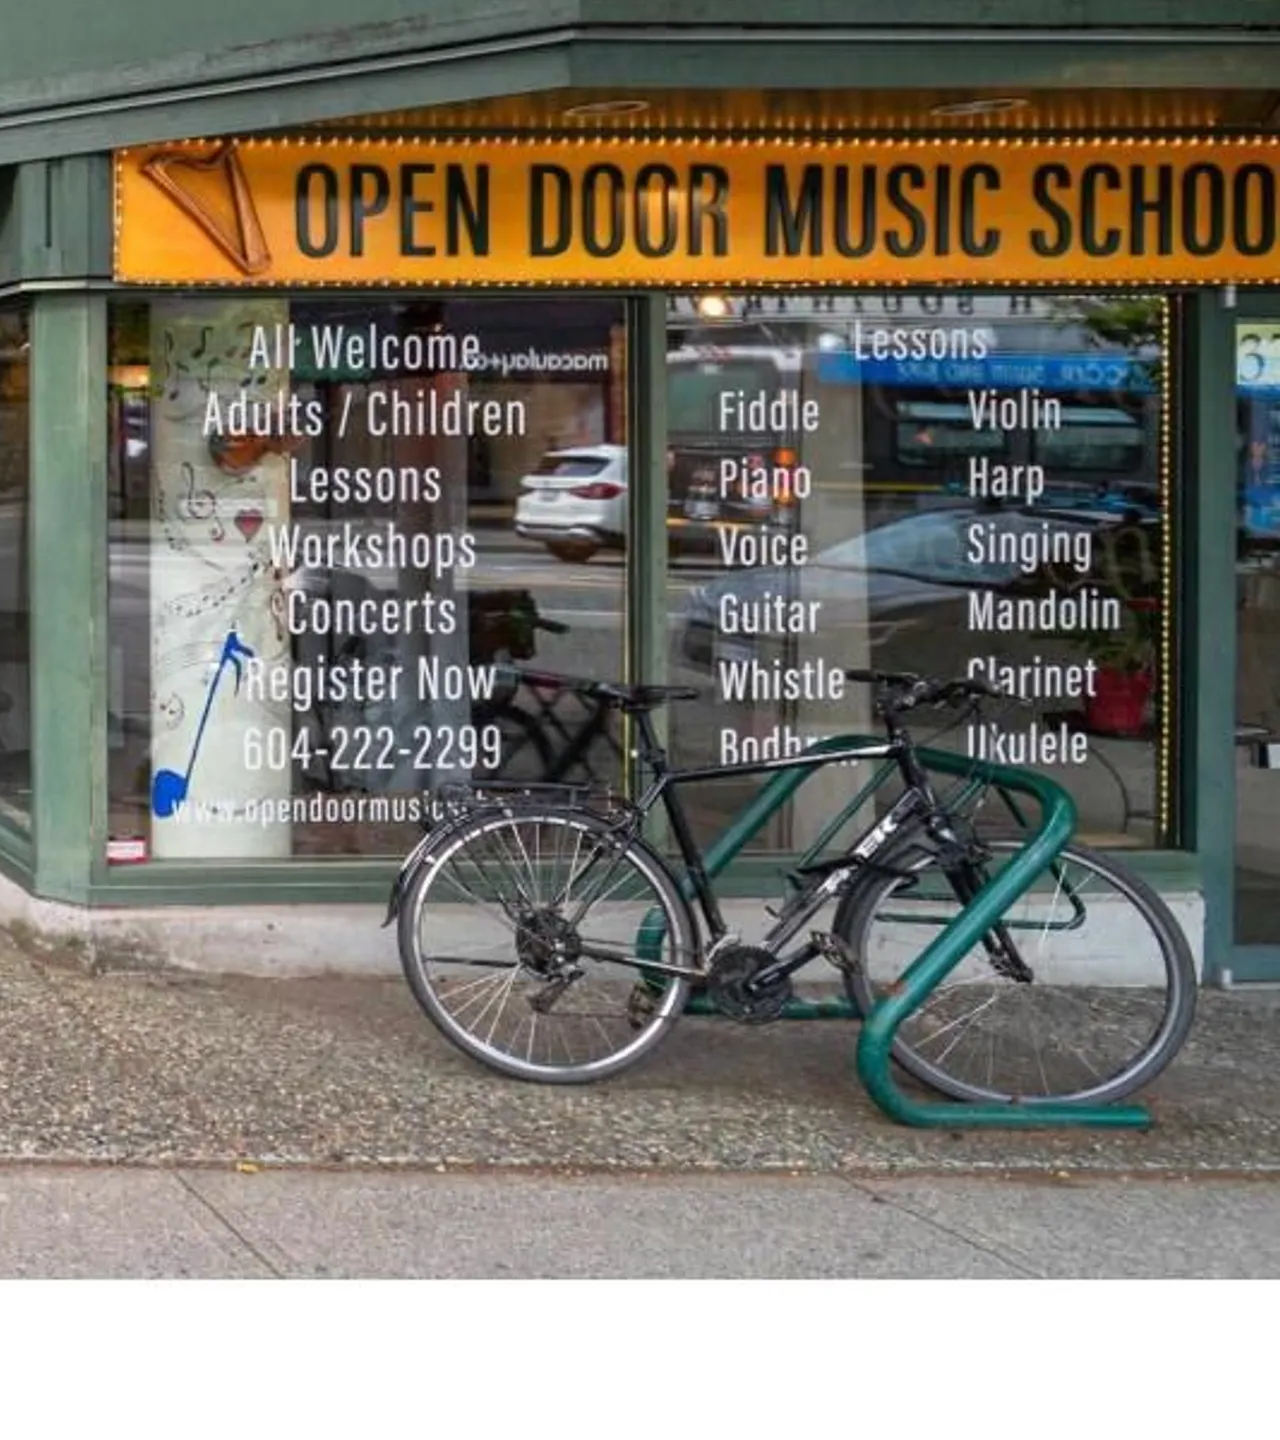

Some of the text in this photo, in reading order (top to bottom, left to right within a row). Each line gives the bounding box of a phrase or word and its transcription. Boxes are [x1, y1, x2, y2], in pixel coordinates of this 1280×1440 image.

[294, 161, 1277, 258] OPEN DOOR MUSIC SCHOO
[248, 323, 481, 370] All Welcome
[853, 321, 989, 360] Lessons
[202, 390, 526, 437] Adults / Children
[720, 391, 820, 431] Fiddle
[967, 390, 1062, 430] Violin
[289, 458, 442, 503] Lessons
[720, 458, 812, 499] Piano
[969, 457, 1044, 508] Harp
[268, 523, 477, 578] Workshops
[719, 525, 809, 566] Voice
[967, 523, 1093, 572] Singing
[287, 589, 457, 635] Concerts
[720, 594, 821, 634] Guitar
[967, 590, 1121, 632] Mandolin
[244, 656, 499, 712] Register Now
[719, 660, 845, 701] Whistle
[243, 725, 502, 770] 604-222-2299
[967, 721, 1088, 765] Ukulele
